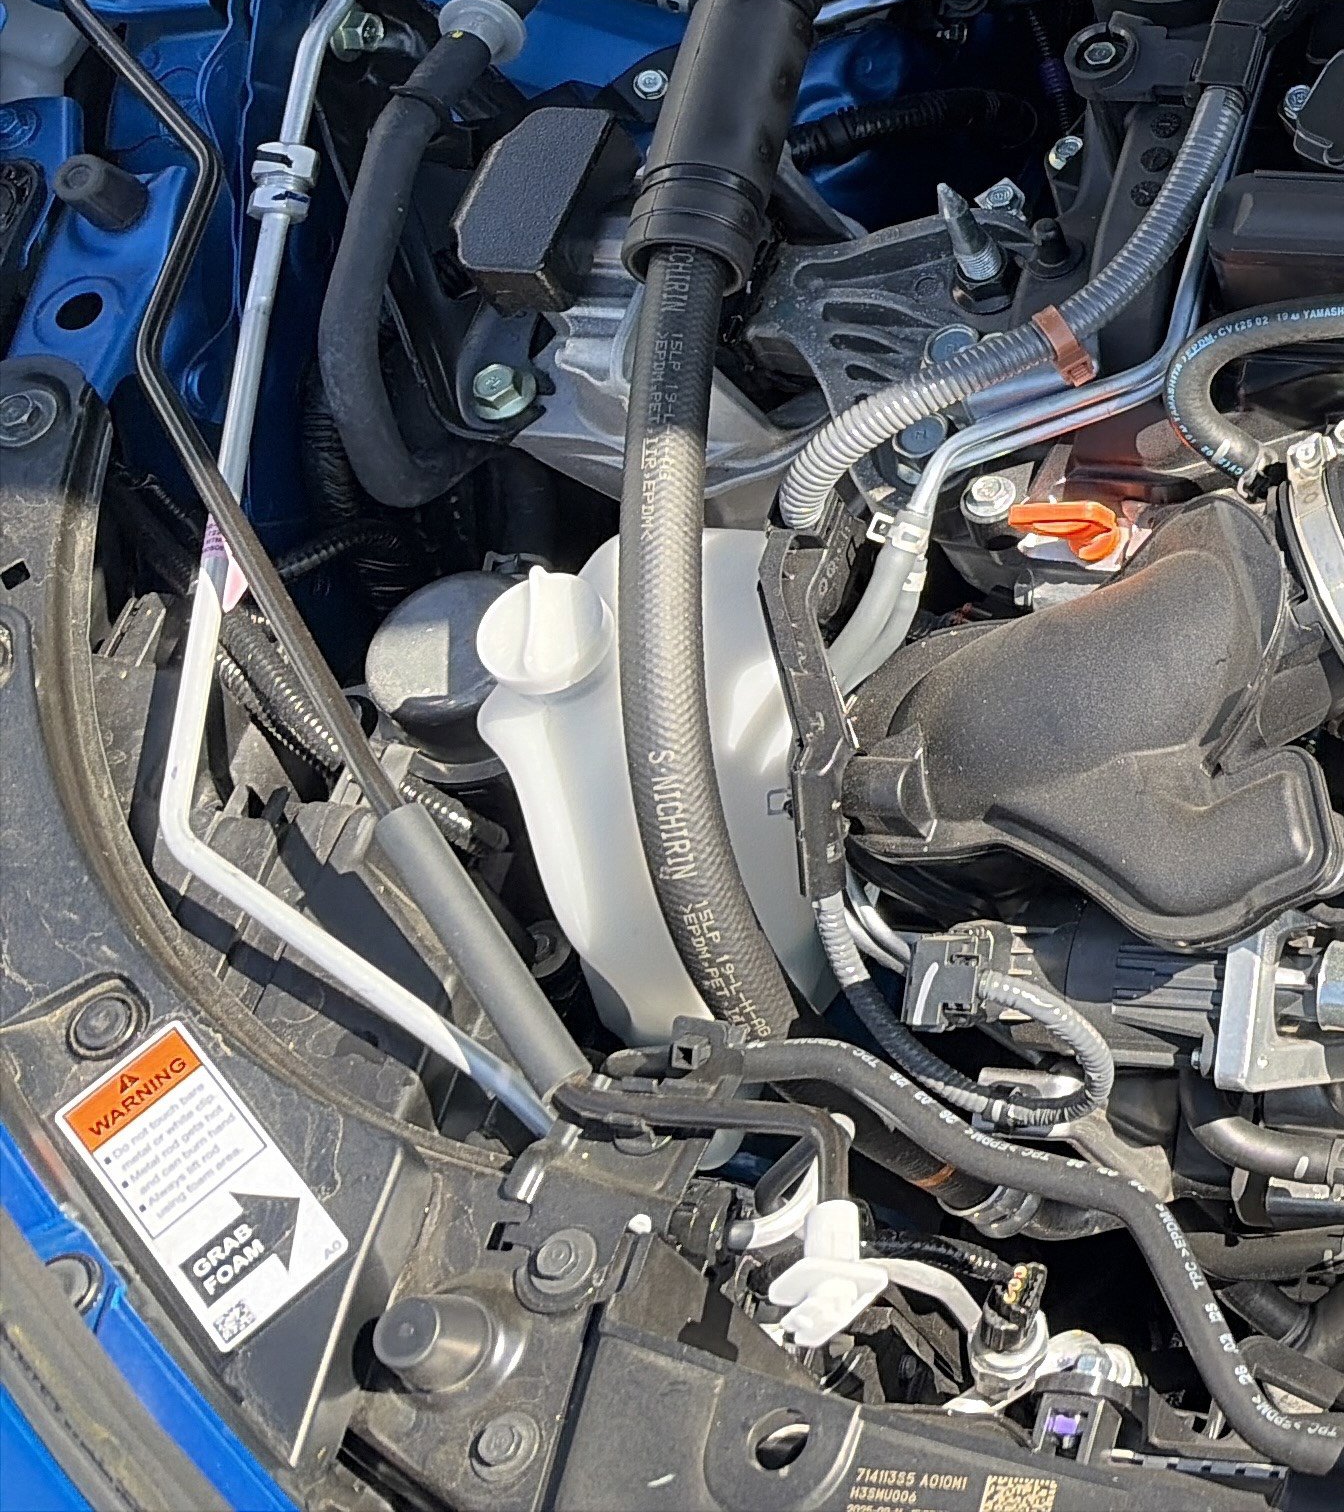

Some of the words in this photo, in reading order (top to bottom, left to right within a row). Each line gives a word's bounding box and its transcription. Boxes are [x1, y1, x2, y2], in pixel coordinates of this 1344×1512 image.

[660, 245, 696, 313] ICHIRIN
[1167, 362, 1183, 423] YAMASHITA
[852, 1048, 881, 1069] TPC
[88, 1057, 188, 1137] WARNING
[112, 1142, 128, 1159] Do
[131, 1128, 148, 1148] not
[148, 1104, 180, 1136] touch
[179, 1083, 205, 1110] bare
[121, 1144, 152, 1171] metal
[129, 1158, 160, 1185] Metal
[161, 1140, 180, 1162] rod
[181, 1121, 204, 1145] gets
[204, 1104, 225, 1124] hot
[139, 1177, 161, 1195] and
[161, 1162, 182, 1181] can
[181, 1139, 208, 1164] burn
[207, 1113, 236, 1141] hand
[148, 1172, 187, 1206] Always
[201, 1144, 221, 1164] rod
[156, 1192, 187, 1219] using
[186, 1170, 215, 1194] foam
[191, 1222, 255, 1279] GRAB
[201, 1238, 265, 1296] FOAM
[1184, 1261, 1207, 1291] TPC
[1307, 1423, 1338, 1438] TPC
